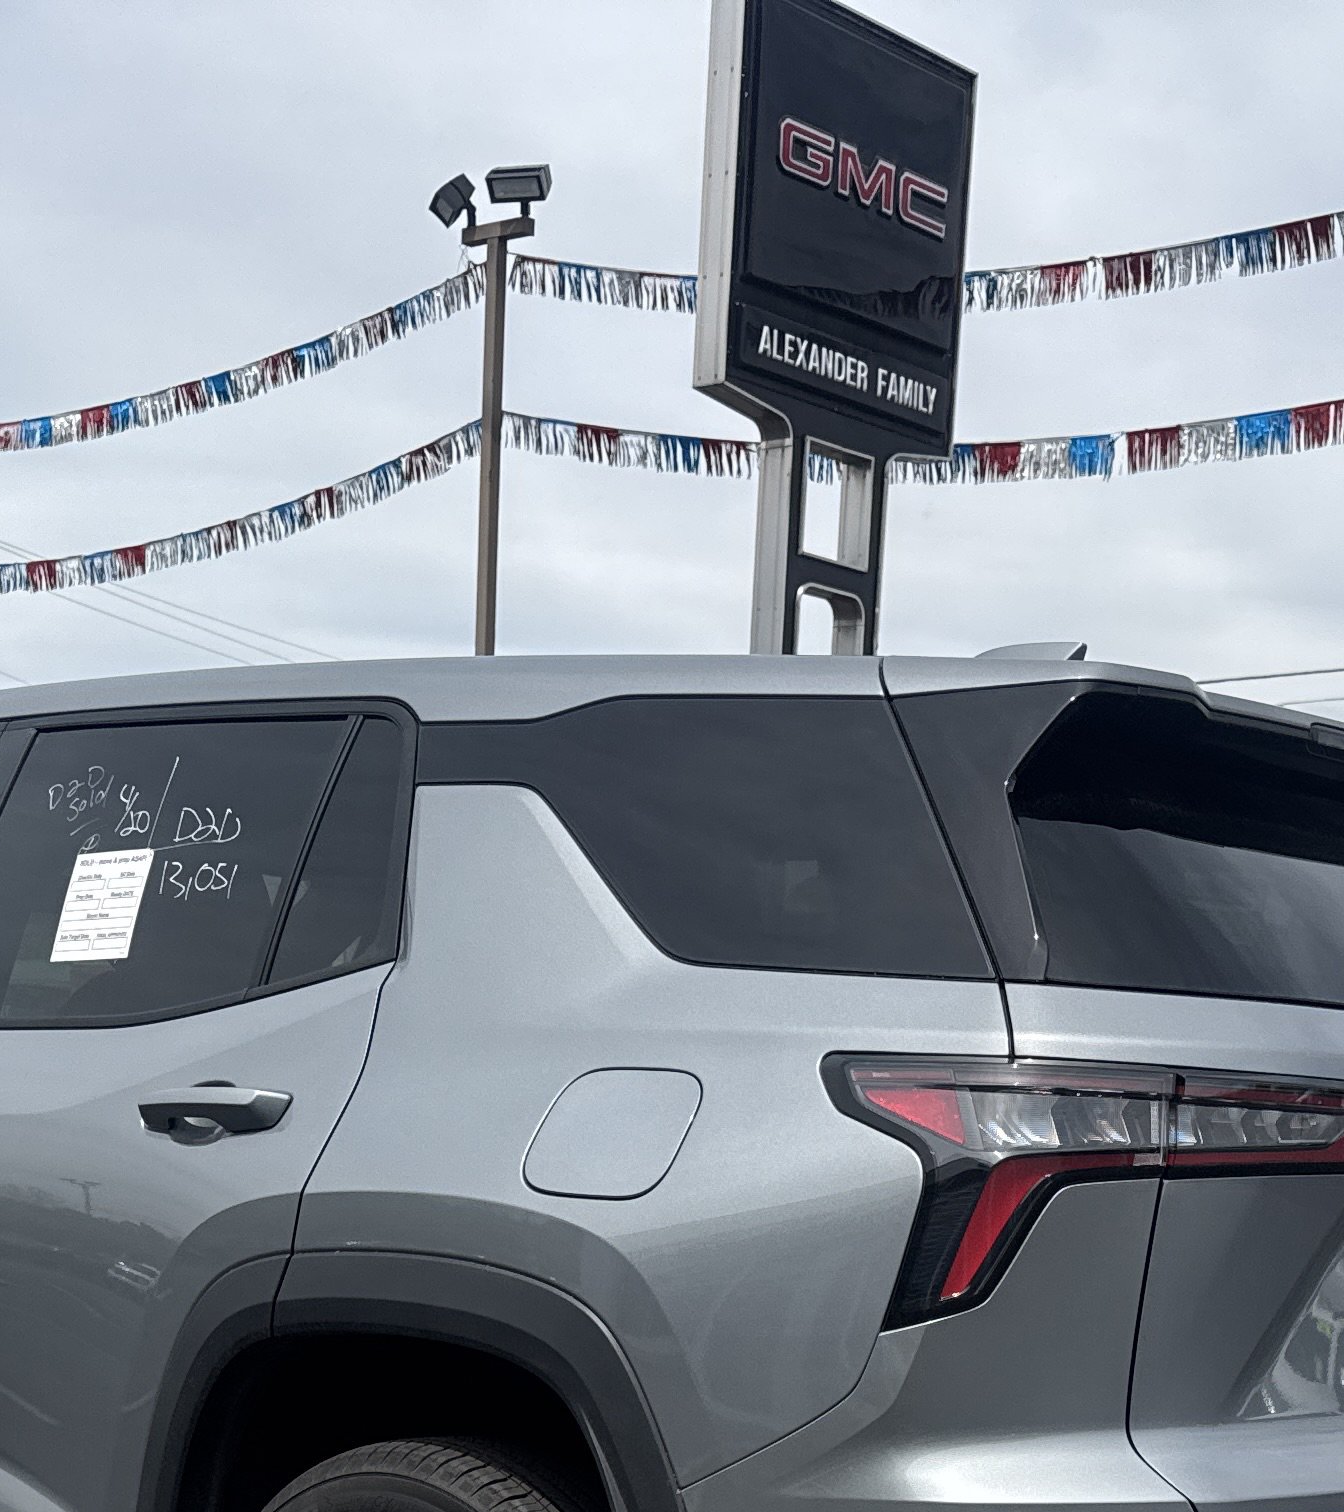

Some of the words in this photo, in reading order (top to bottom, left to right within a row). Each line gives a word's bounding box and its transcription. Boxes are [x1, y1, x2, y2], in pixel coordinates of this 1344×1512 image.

[779, 117, 949, 239] GMC
[758, 325, 869, 393] ALEXANDER
[876, 367, 938, 415] FAMILY
[158, 860, 239, 901] 13,051
